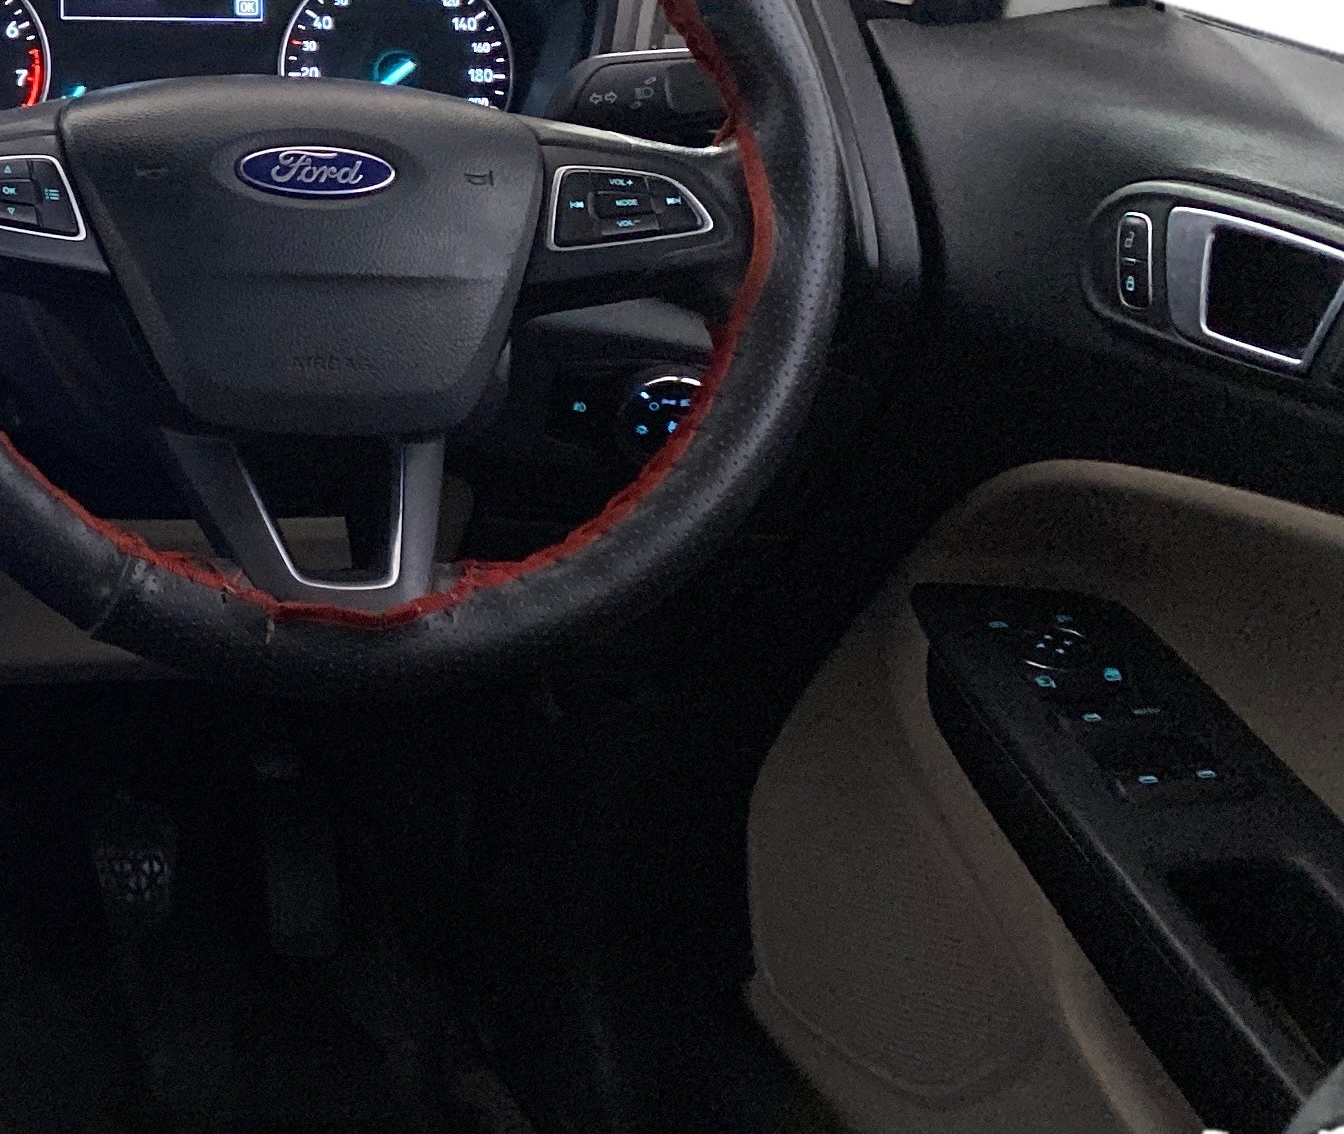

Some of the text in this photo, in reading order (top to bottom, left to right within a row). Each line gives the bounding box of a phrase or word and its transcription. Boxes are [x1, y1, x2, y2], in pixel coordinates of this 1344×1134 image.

[239, 2, 256, 13] OK
[6, 21, 19, 38] 6
[313, 16, 333, 30] 40
[452, 17, 478, 31] 140
[302, 40, 318, 52] 30
[471, 42, 491, 54] 160
[16, 69, 28, 86] 7
[301, 67, 318, 78] 20
[467, 68, 493, 83] 180
[271, 150, 363, 184] Ford
[2, 185, 17, 195] OK
